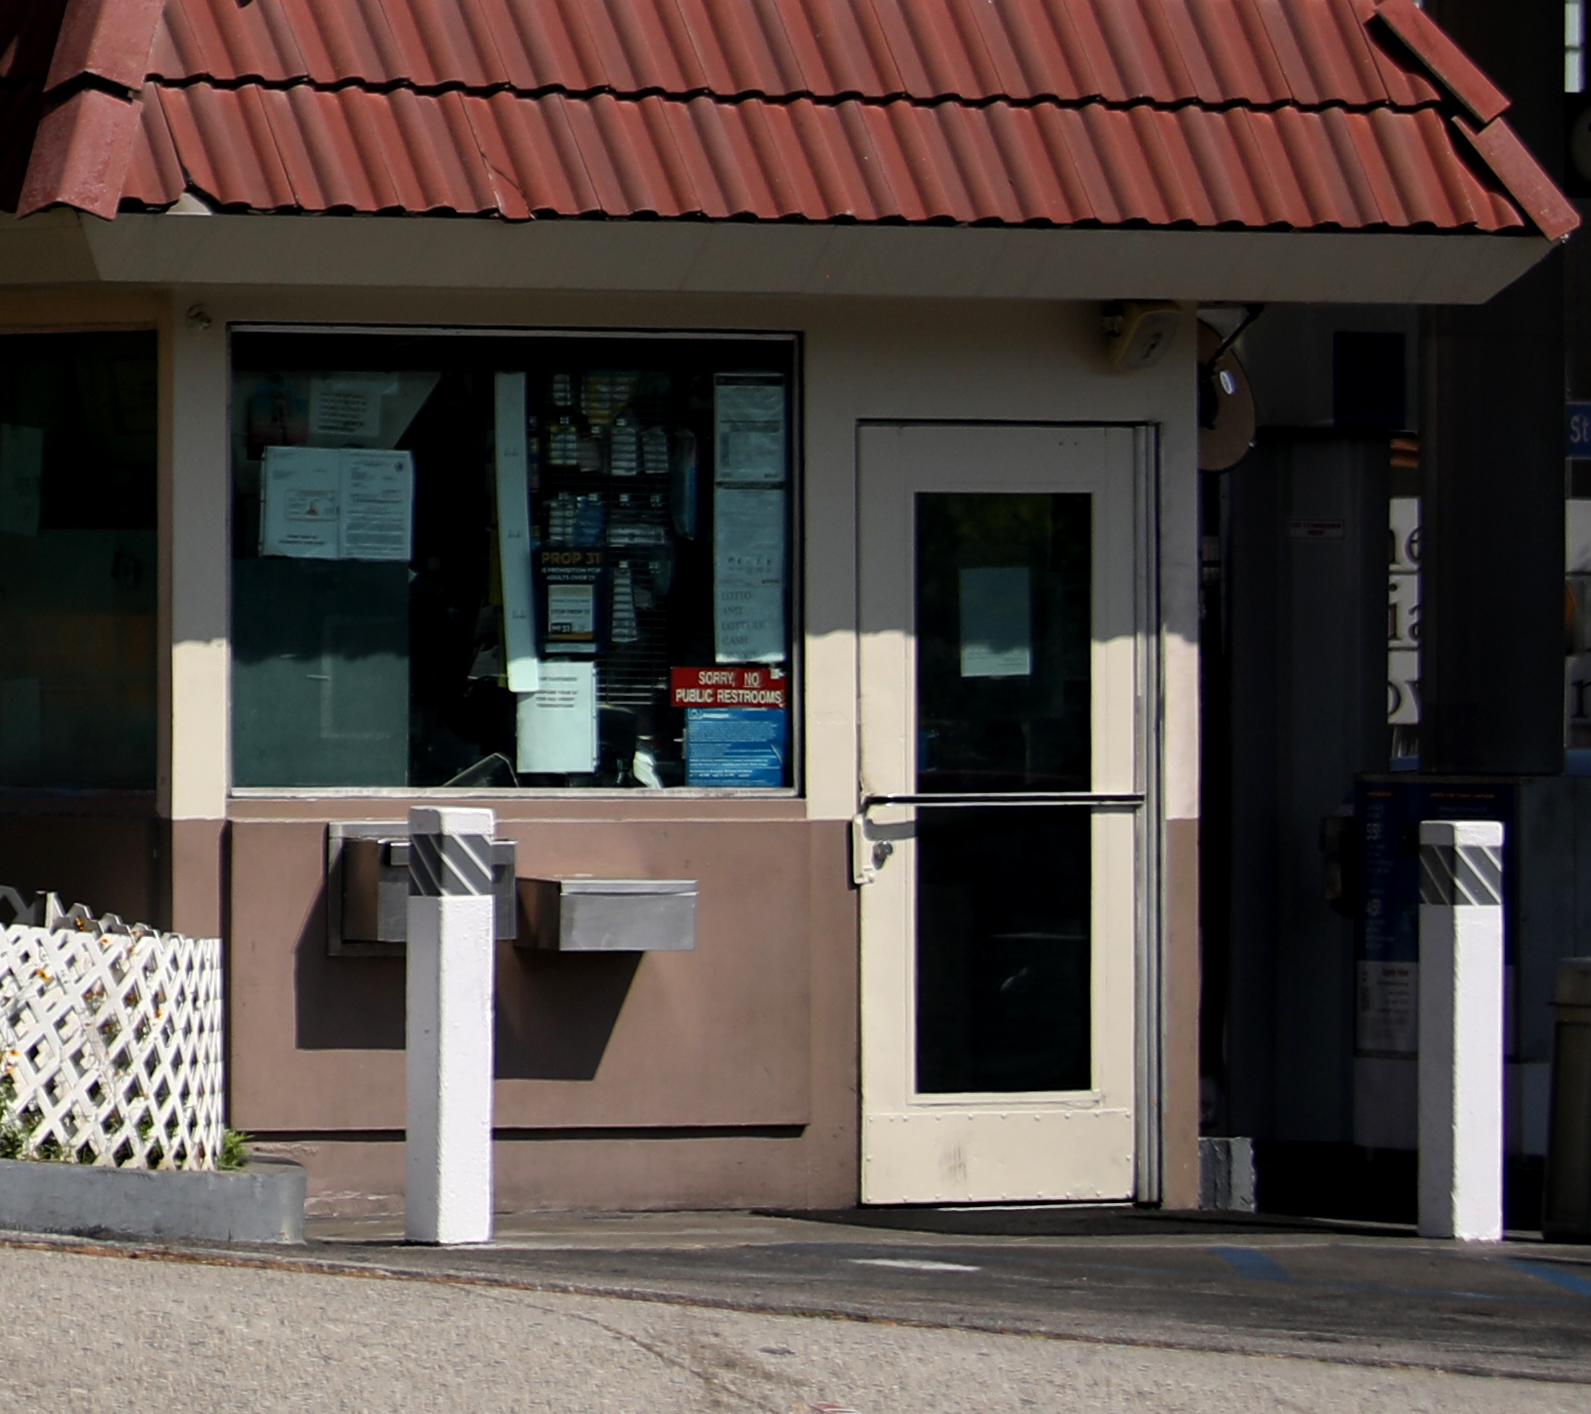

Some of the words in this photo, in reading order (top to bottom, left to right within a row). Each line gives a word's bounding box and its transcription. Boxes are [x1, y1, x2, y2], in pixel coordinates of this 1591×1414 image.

[541, 551, 583, 565] PROP
[585, 551, 602, 565] 31
[698, 670, 736, 687] SORRY,
[744, 672, 761, 686] NO
[675, 688, 715, 703] PUBLIC
[717, 689, 783, 704] RESTROOMS
